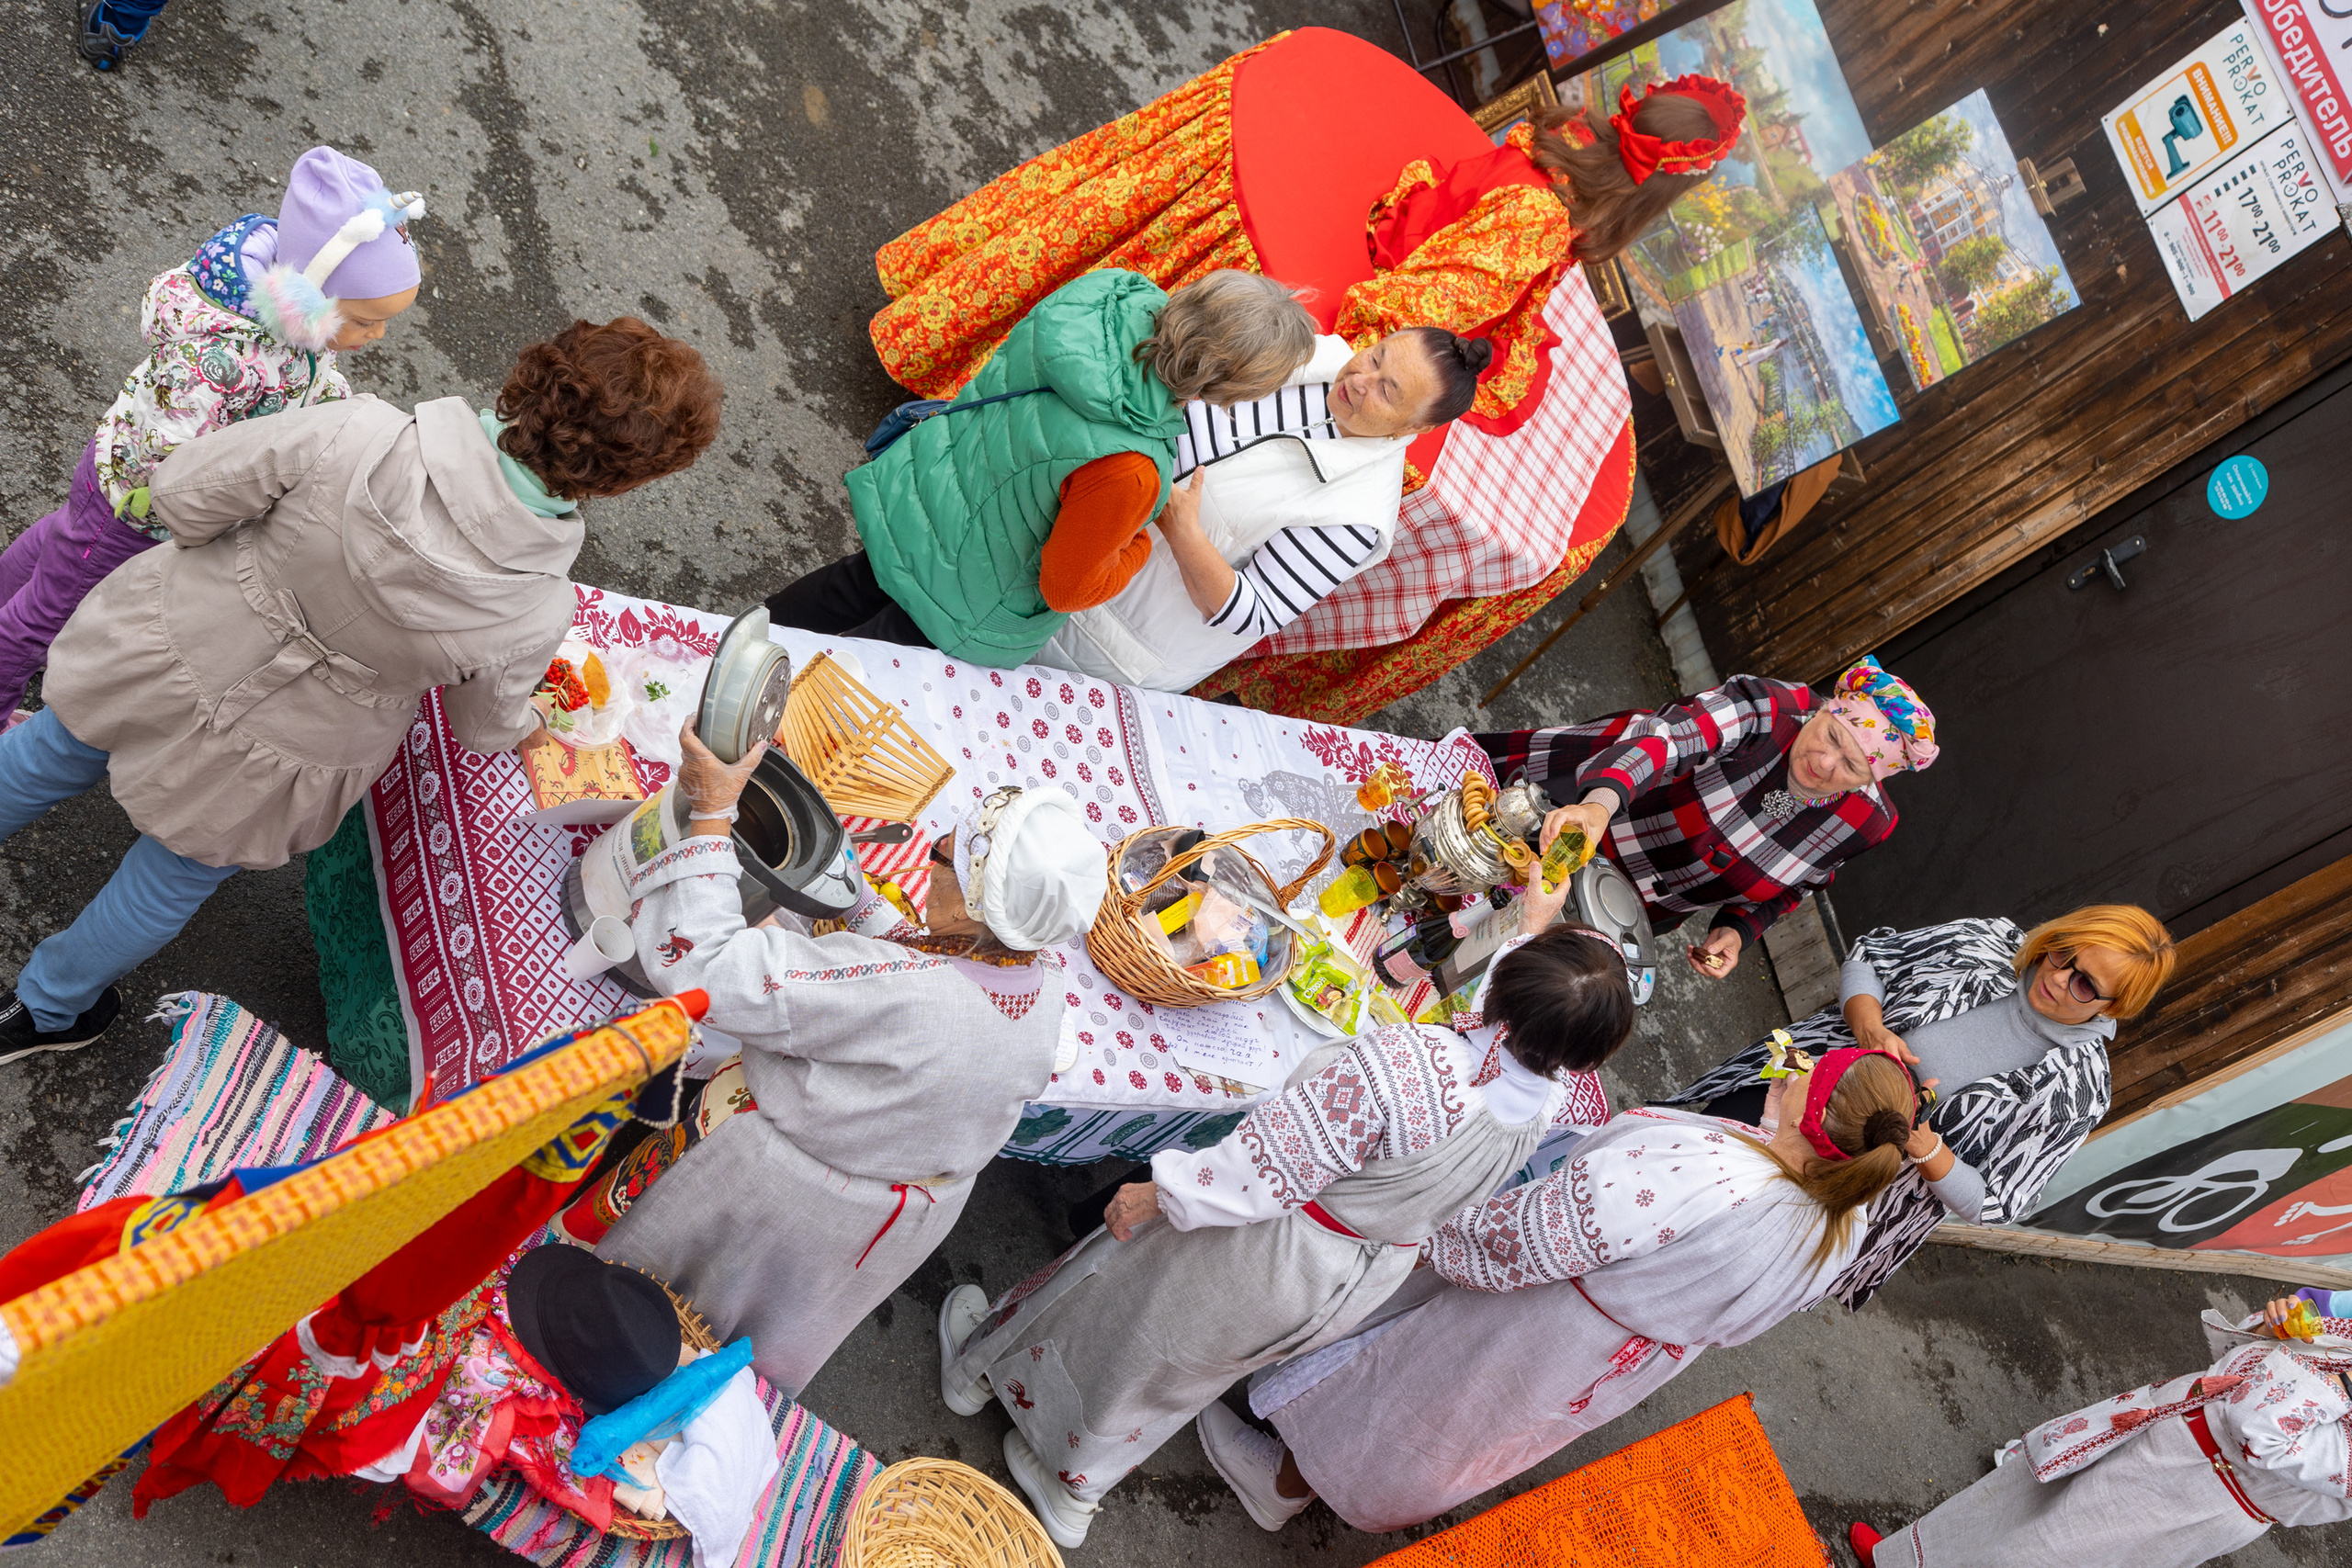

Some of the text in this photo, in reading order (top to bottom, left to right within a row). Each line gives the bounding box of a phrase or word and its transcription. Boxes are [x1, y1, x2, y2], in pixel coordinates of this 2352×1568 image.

[2222, 53, 2265, 126] PROKAT
[2230, 33, 2267, 96] PERVO
[2192, 67, 2233, 145] ВНИМАНИЕ!!!
[2119, 121, 2156, 197] ВИДЕОНАБЛЮДЕНИЕ
[2272, 159, 2316, 231] PROKAT
[2280, 139, 2318, 202] PERVO
[812, 876, 830, 896] Maxwell
